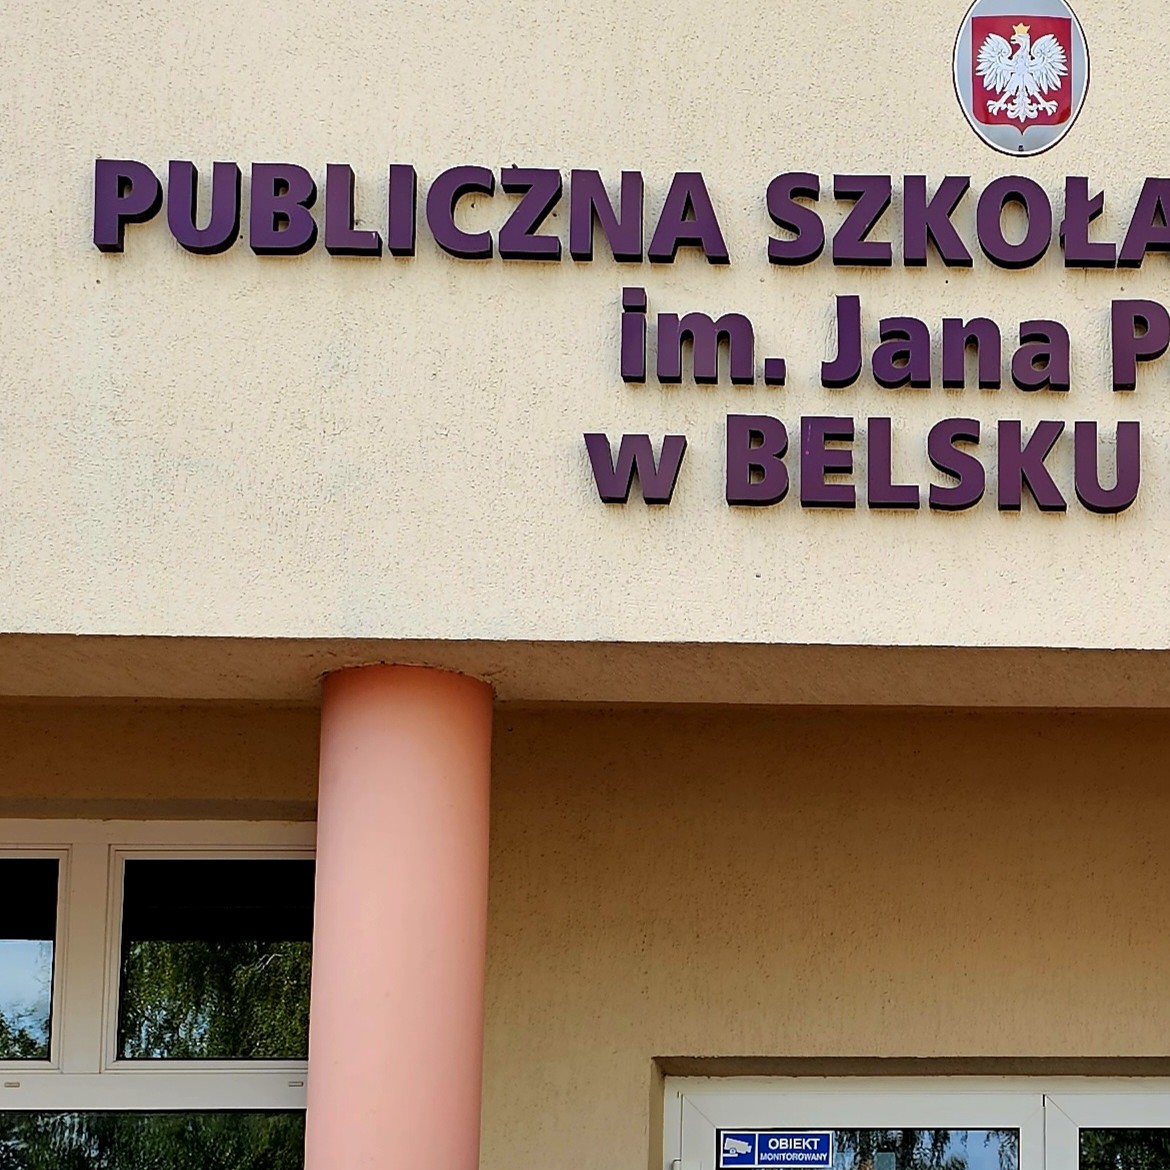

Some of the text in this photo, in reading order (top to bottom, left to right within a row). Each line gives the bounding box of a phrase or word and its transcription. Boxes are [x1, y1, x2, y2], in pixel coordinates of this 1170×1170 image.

[94, 159, 730, 266] PUBLICZNA
[620, 287, 787, 387] im.
[820, 294, 1072, 394] Jana
[583, 432, 688, 509] w
[725, 414, 1140, 517] BELSKU
[760, 1153, 827, 1161] MONITOROWANY
[768, 1138, 820, 1150] OBIEKT
